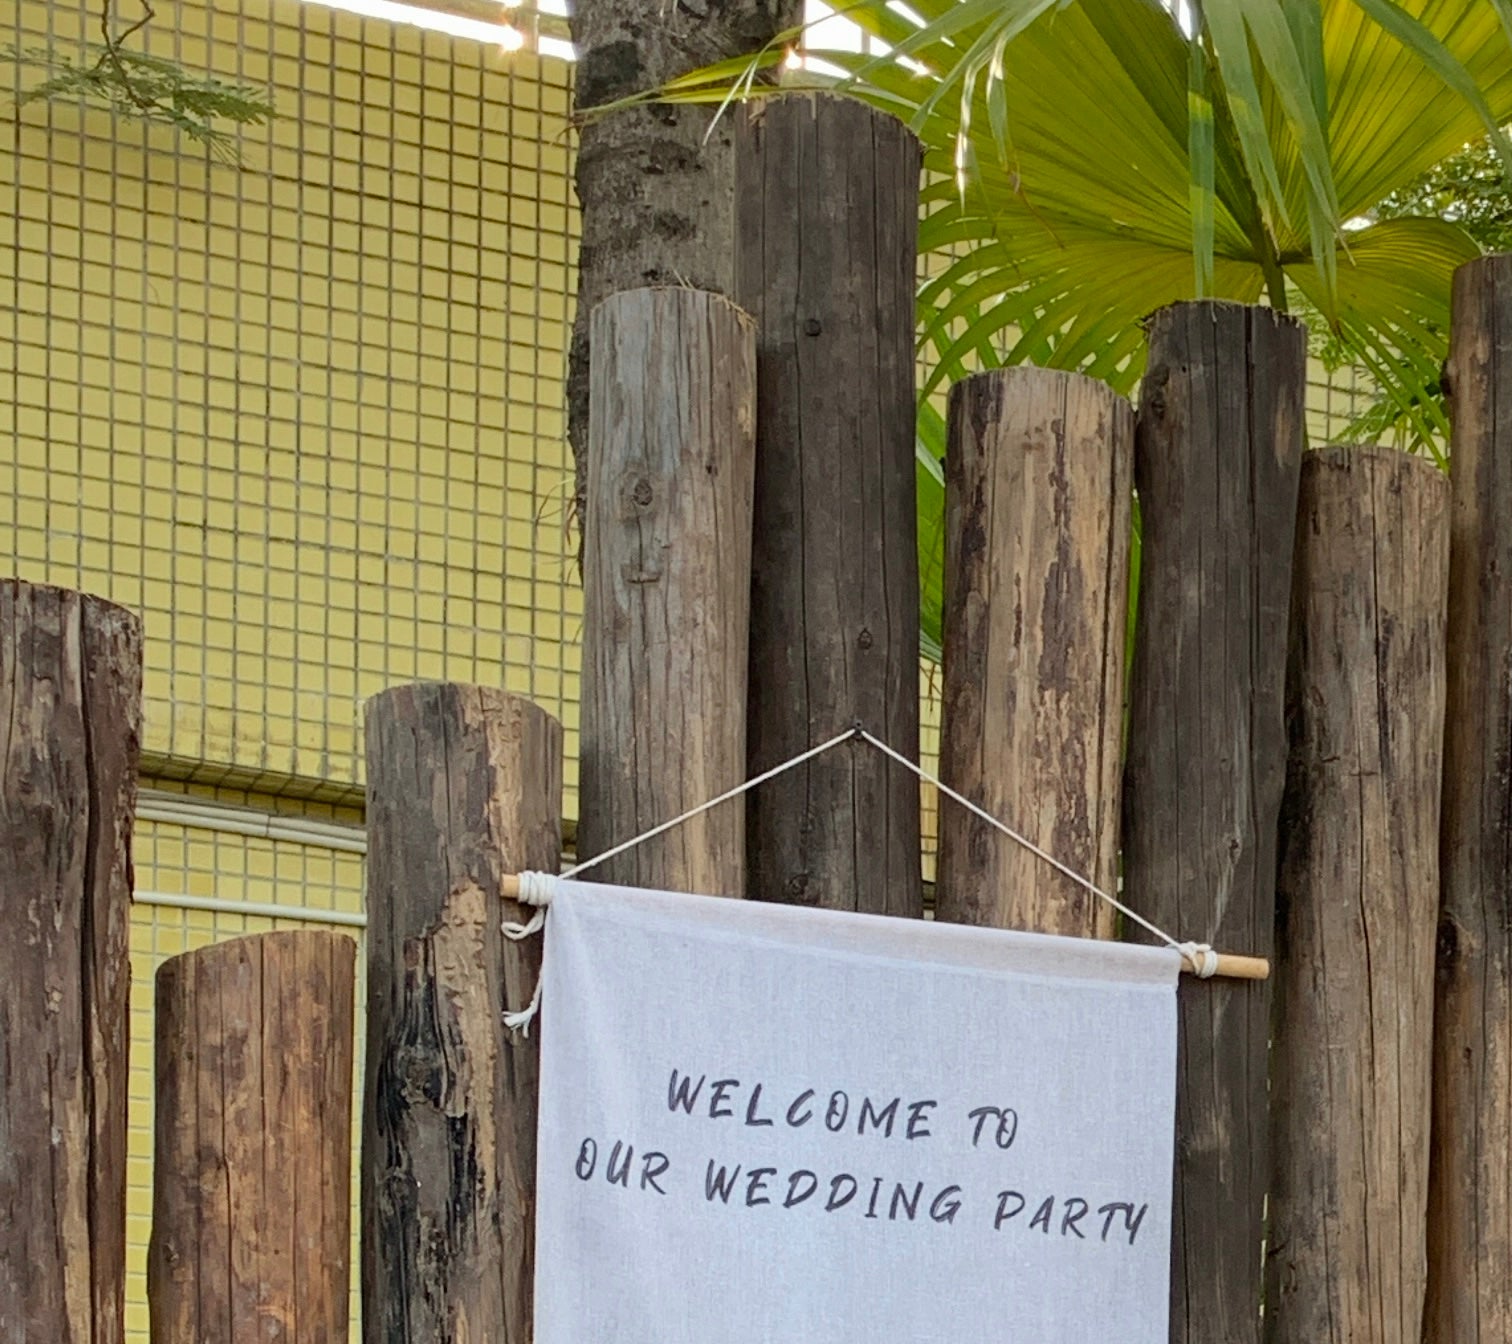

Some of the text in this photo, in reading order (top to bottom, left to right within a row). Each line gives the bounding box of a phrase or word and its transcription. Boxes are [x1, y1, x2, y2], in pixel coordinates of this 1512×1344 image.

[667, 1068, 1019, 1149] WELCOME TO
[575, 1136, 1149, 1246] OUR WEDDING PARTY
